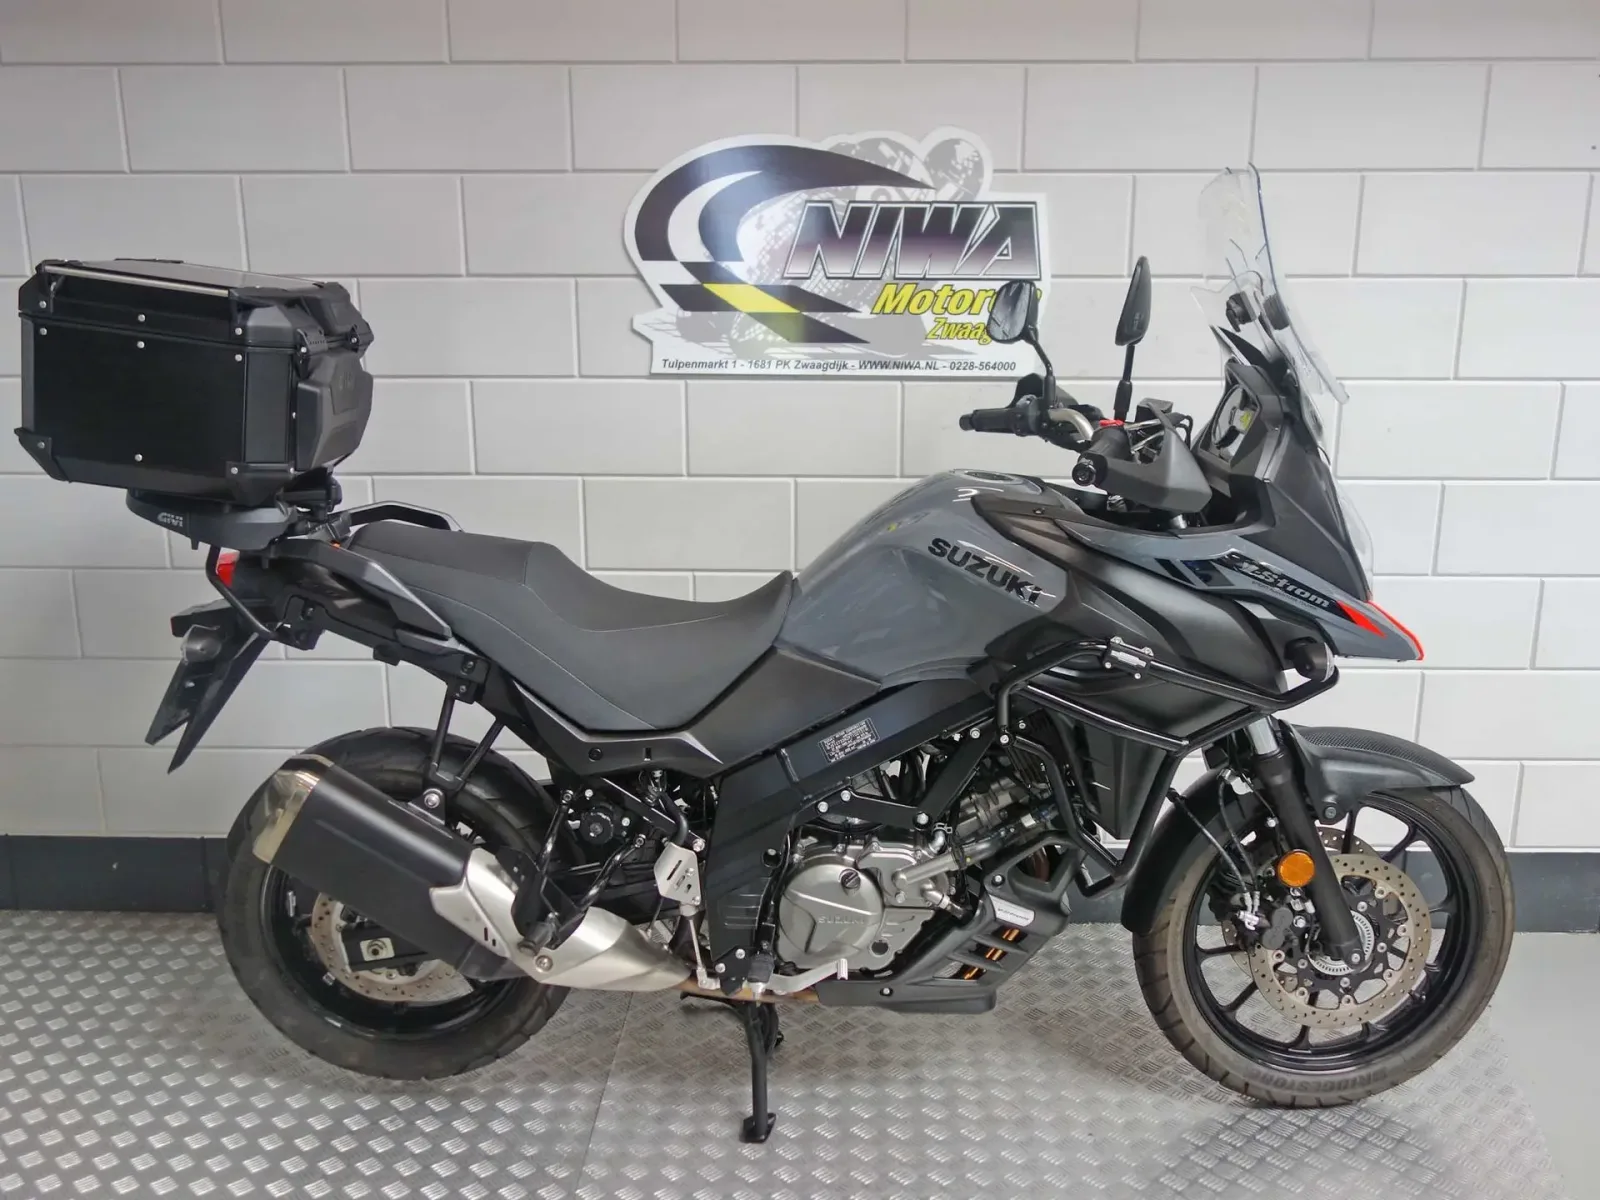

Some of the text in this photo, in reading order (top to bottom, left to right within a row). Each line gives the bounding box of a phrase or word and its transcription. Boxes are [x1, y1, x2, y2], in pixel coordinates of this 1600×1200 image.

[781, 201, 1041, 280] NIWA
[870, 282, 1042, 315] Motor
[662, 359, 728, 370] Tulpenmarkt
[732, 360, 738, 369] 1
[748, 360, 772, 369] 1681
[775, 360, 790, 369] PK
[794, 360, 848, 371] Zwaagdijk
[858, 361, 939, 371] WWW.NIWA.NL
[950, 361, 1016, 371] 0228-564000
[928, 537, 1042, 604] SUZUKI
